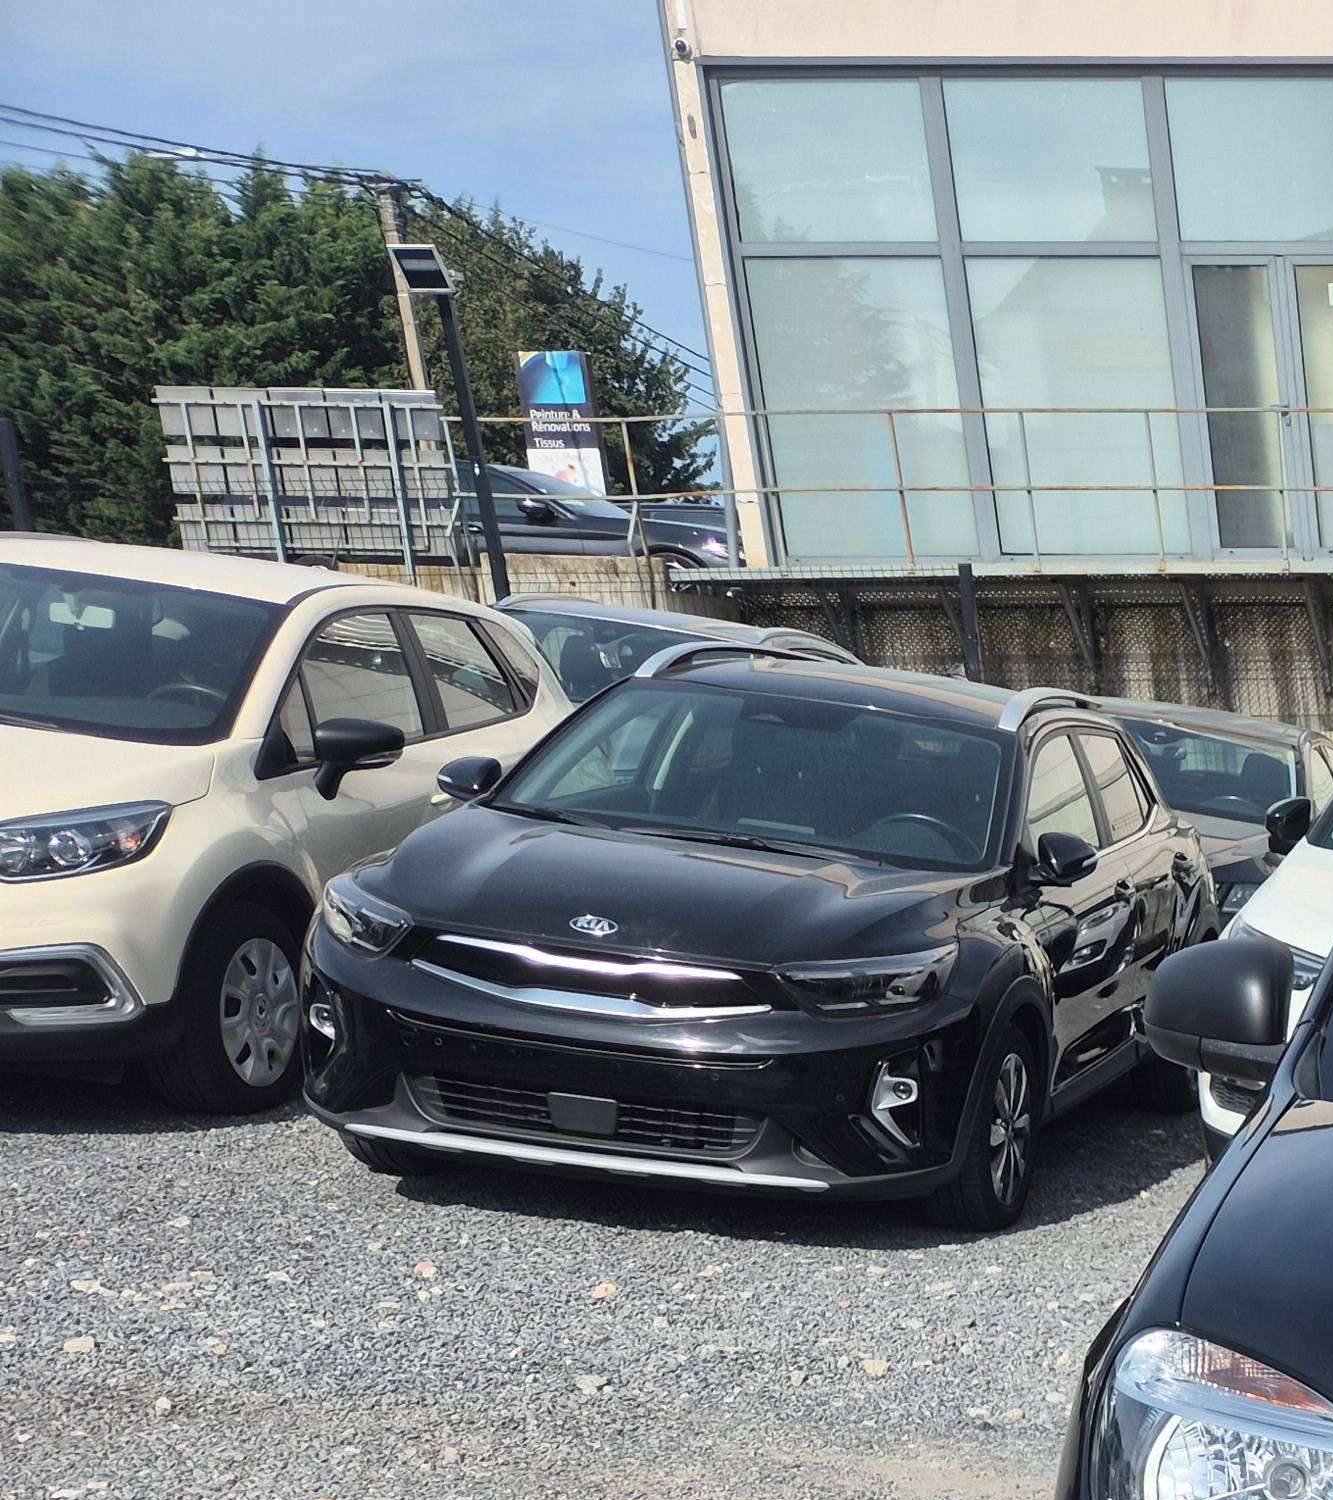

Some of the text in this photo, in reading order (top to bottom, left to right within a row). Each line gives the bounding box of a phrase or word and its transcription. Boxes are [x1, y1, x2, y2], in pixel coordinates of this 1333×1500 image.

[572, 410, 581, 420] &
[534, 438, 565, 448] Tissus
[576, 917, 609, 931] KIA
